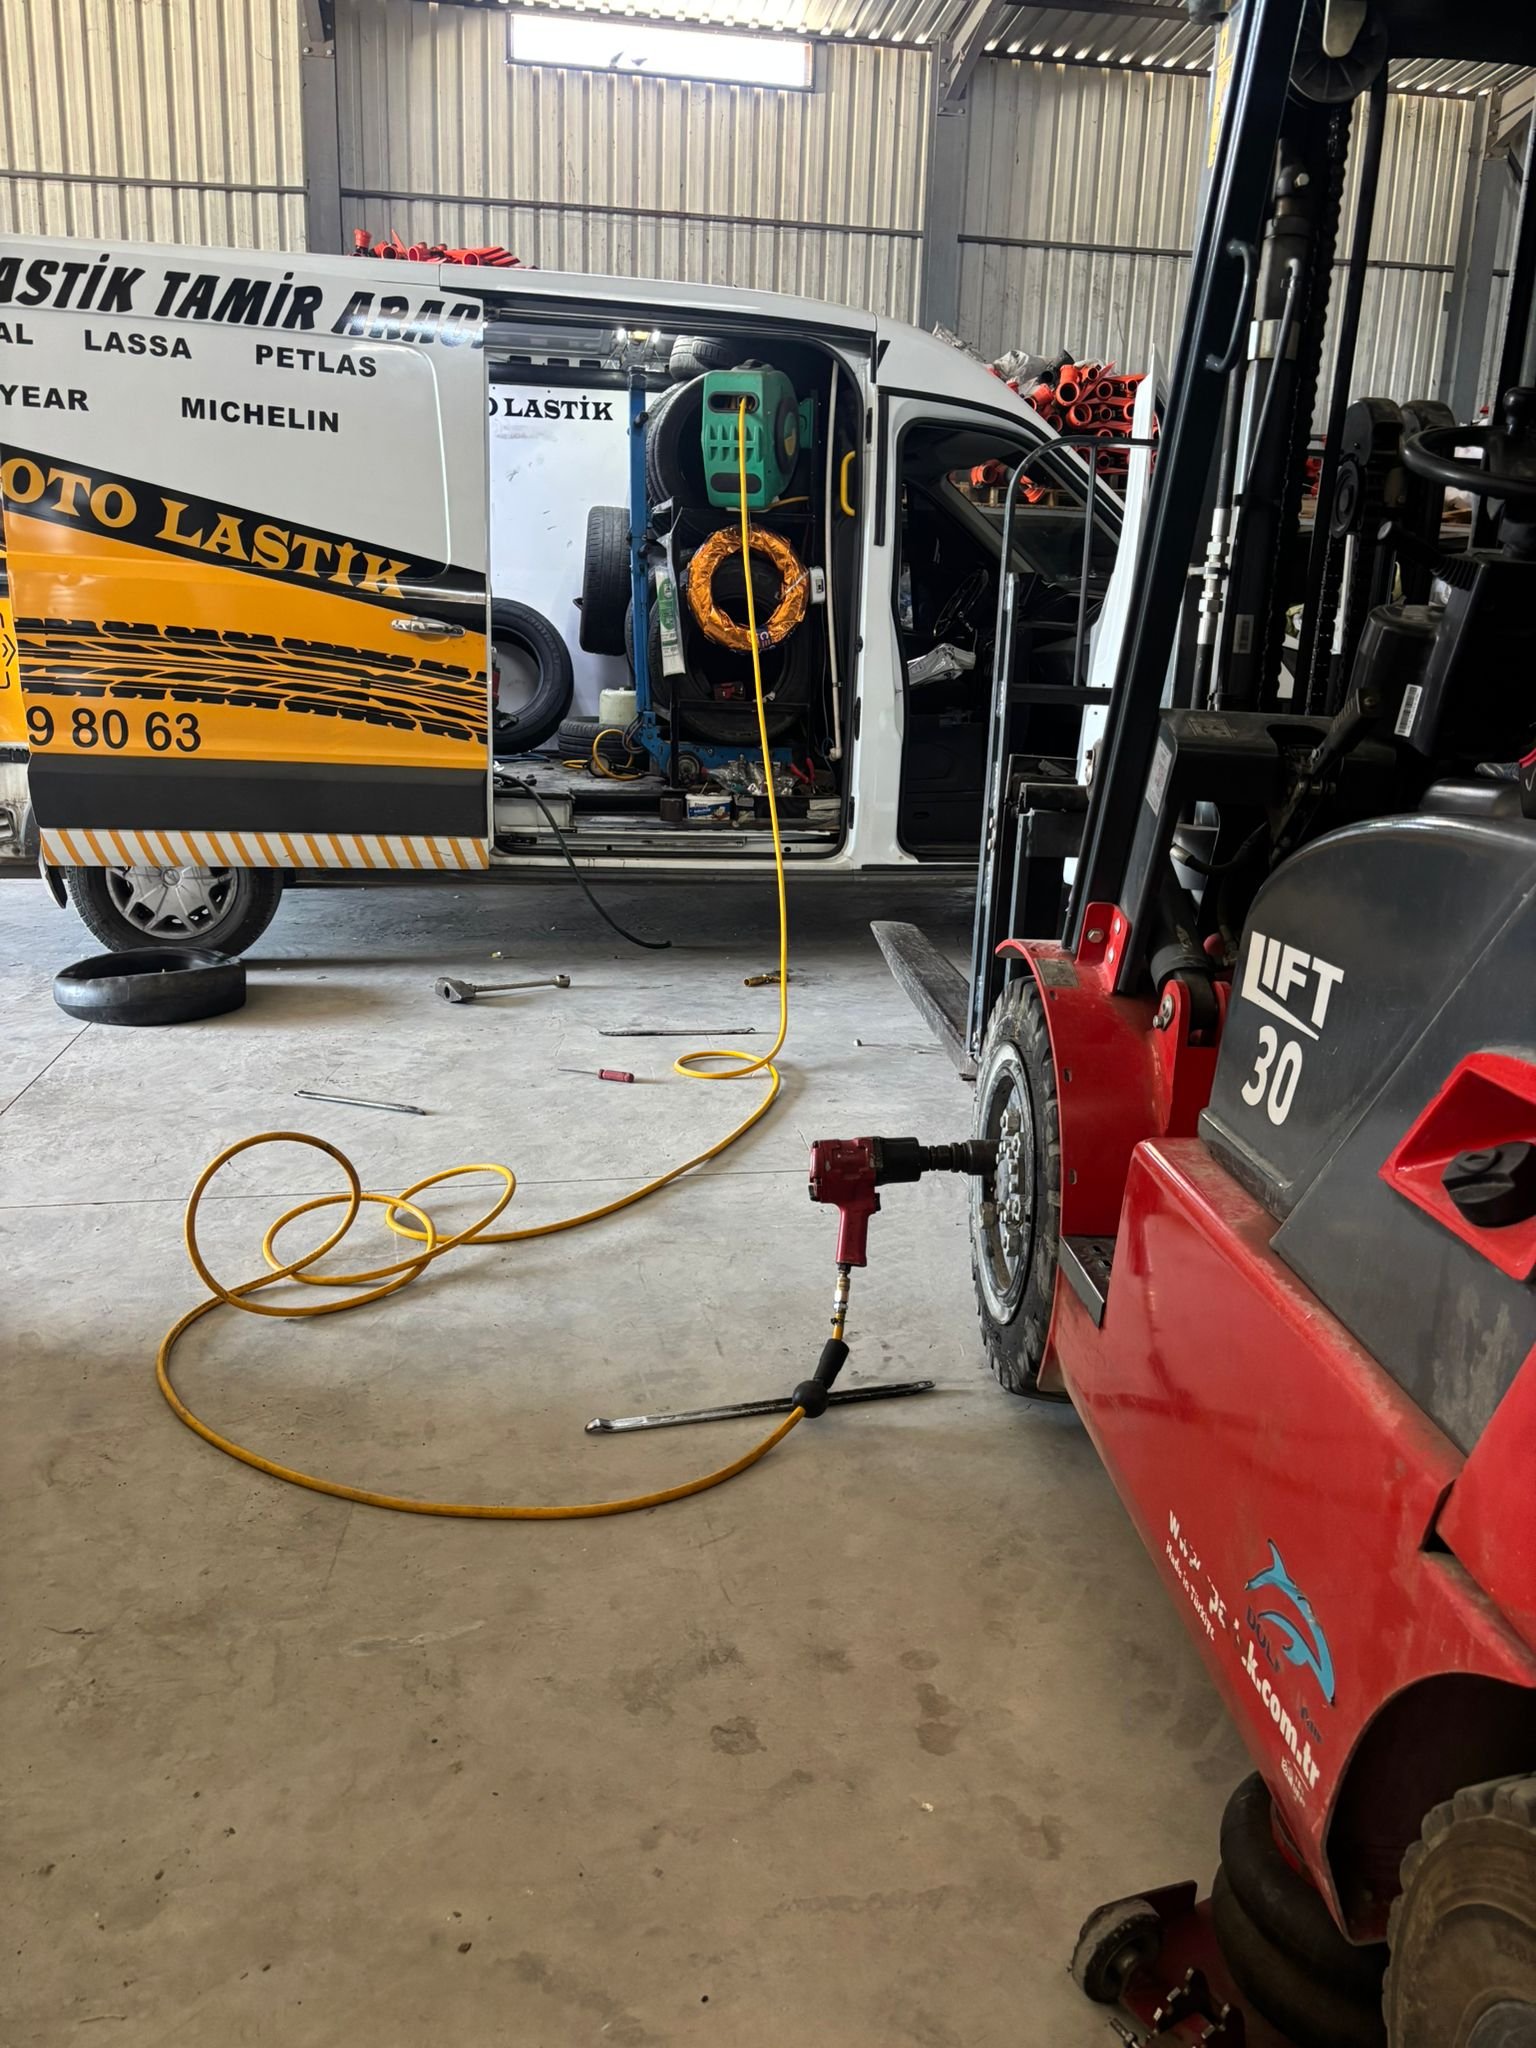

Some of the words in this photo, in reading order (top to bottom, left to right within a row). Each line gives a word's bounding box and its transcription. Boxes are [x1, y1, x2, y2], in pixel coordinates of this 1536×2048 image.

[154, 271, 323, 331] TAMİR
[84, 329, 192, 359] LASSA
[256, 344, 377, 377] PETLAS
[0, 384, 89, 411] YEAR
[181, 397, 339, 433] MICHELIN
[504, 395, 613, 421] LASTİK
[1, 457, 137, 528] OTO
[155, 497, 412, 599] LASTİK
[26, 705, 55, 746] 9
[71, 708, 129, 750] 80
[145, 711, 202, 752] 63
[1241, 930, 1345, 1041] LIFT
[1241, 1025, 1303, 1126] 30
